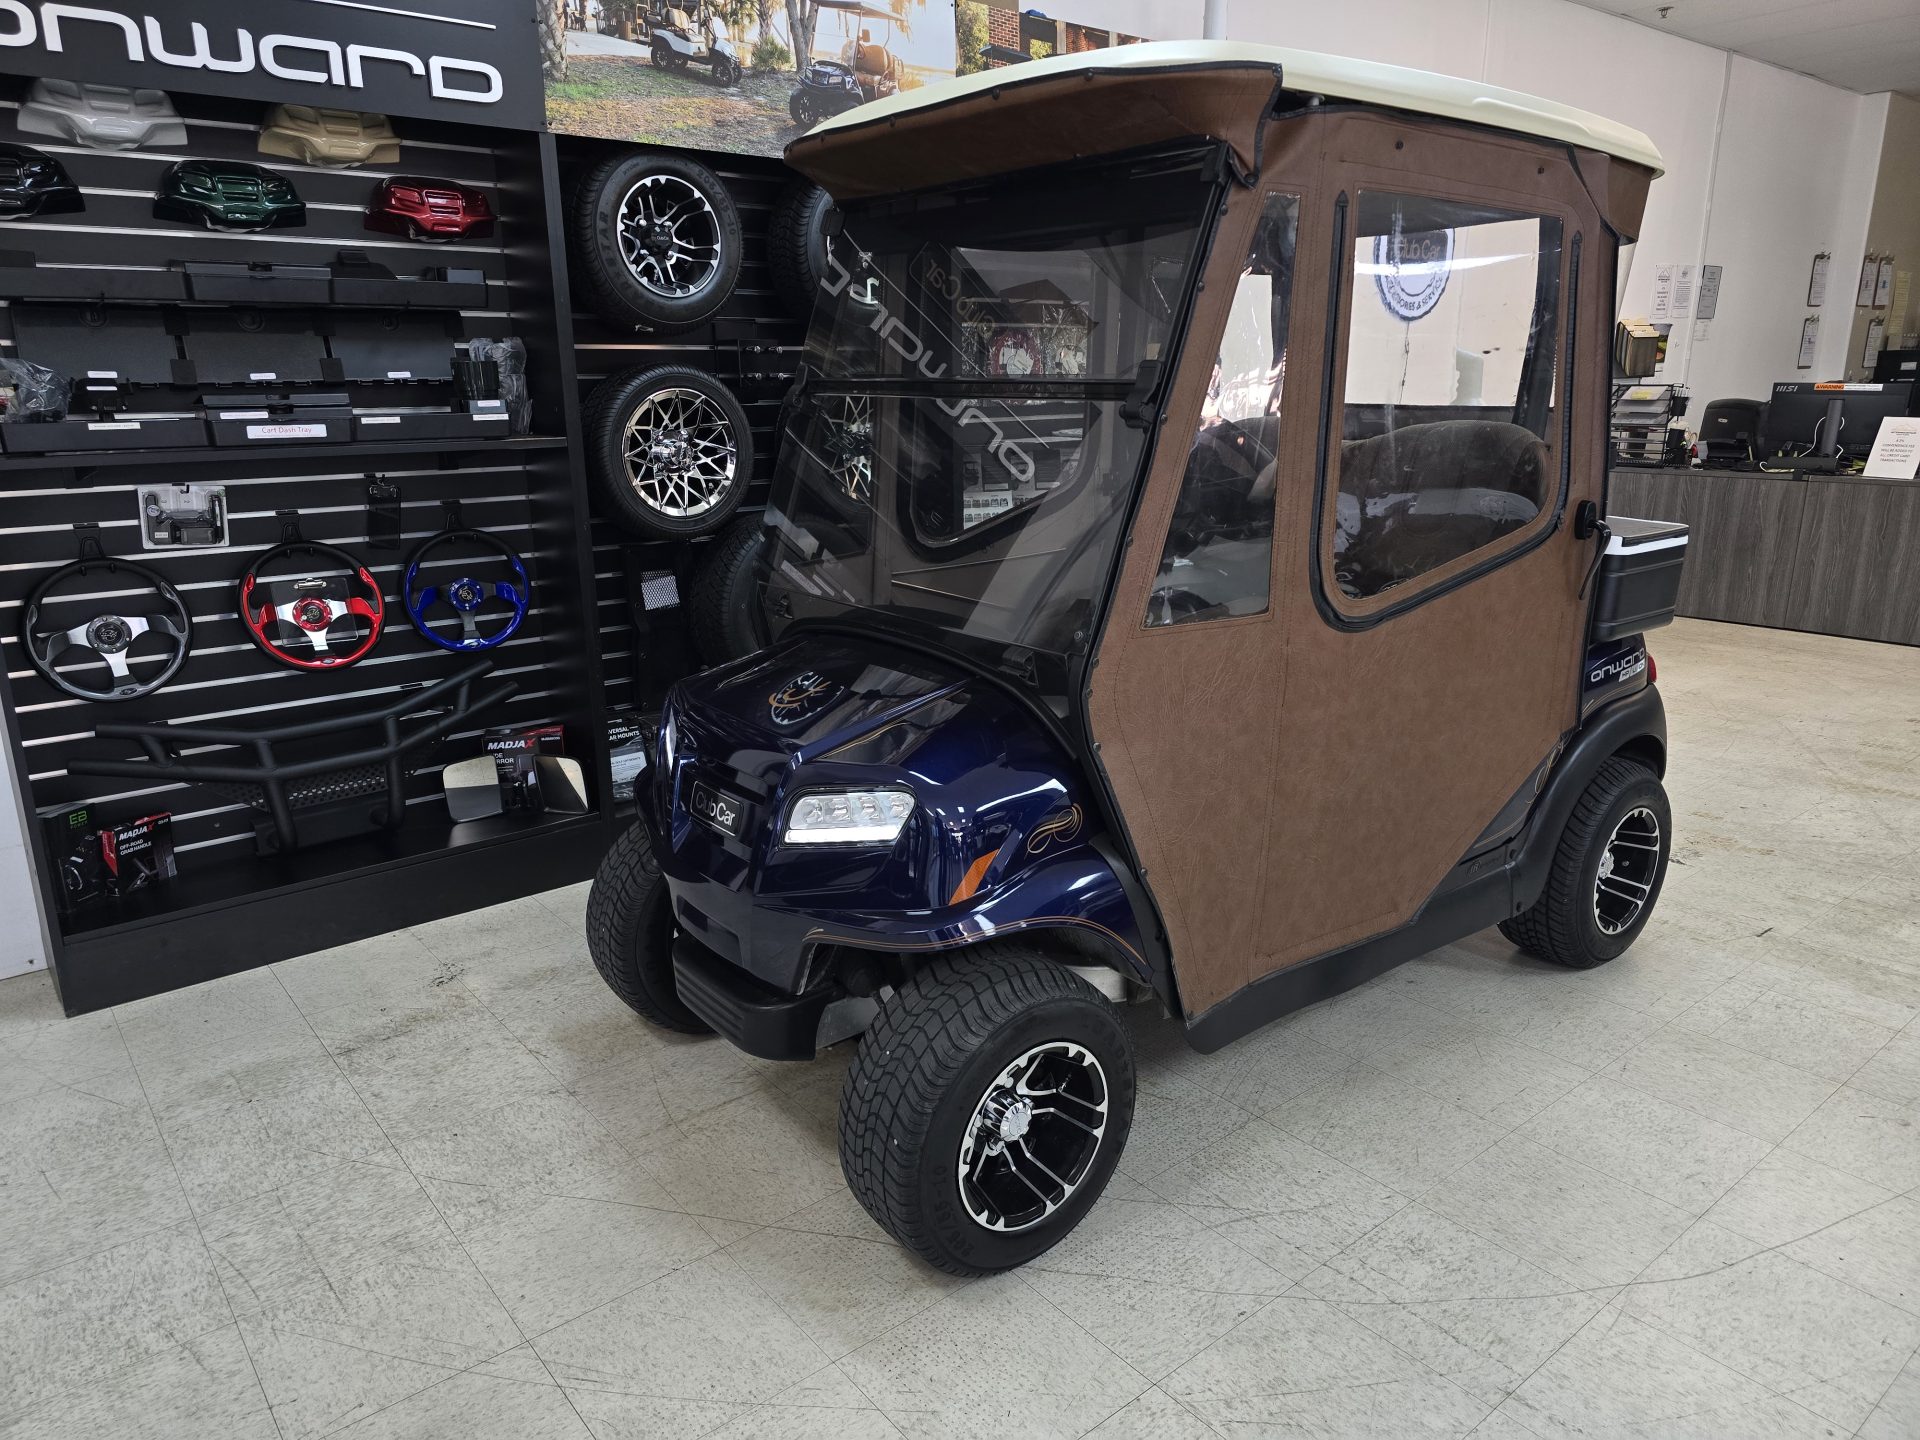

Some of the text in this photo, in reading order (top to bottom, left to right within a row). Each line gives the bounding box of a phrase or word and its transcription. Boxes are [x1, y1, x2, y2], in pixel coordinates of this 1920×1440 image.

[1422, 240, 1441, 260] Car
[617, 730, 640, 739] MOUNTS
[488, 738, 536, 750] MADJAX
[69, 811, 88, 824] EB
[717, 802, 736, 826] Car
[119, 822, 155, 841] MADJAX
[120, 839, 144, 850] OFF-ROAD
[120, 841, 152, 856] GRAB HANDLE
